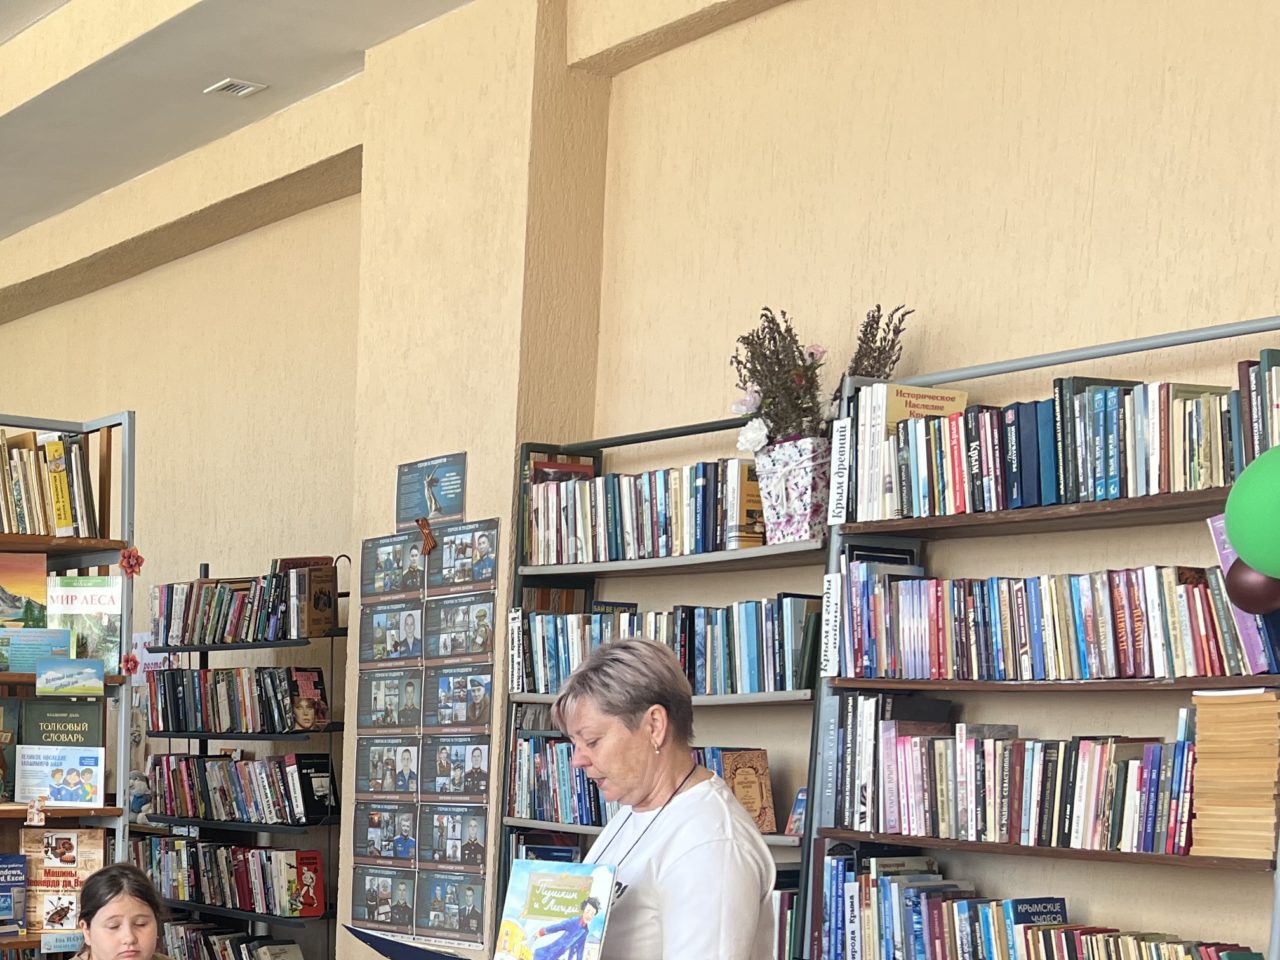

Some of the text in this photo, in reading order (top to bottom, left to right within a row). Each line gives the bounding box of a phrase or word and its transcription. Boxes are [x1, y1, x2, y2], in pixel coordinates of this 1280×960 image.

[896, 389, 956, 402] Историческое
[904, 400, 945, 411] Наследие
[968, 440, 980, 474] Крым
[831, 425, 848, 519] Крым древний
[49, 594, 116, 606] МИР ЛЕСА
[823, 579, 832, 615] годы
[821, 630, 831, 673] Крым
[38, 722, 89, 732] ТОЛКОВЫЙ
[41, 733, 84, 743] СЛОВАРЬ
[1002, 750, 1010, 796] СЕВАСТОПОЛЬ
[7, 874, 25, 882] Excel
[43, 868, 77, 877] Машины
[536, 878, 578, 903] Пушкин
[543, 901, 580, 914] Лицей
[848, 894, 856, 924] Крыма
[1018, 903, 1062, 913] КРЫМСКИЕ
[1031, 914, 1063, 923] ЧУДЕСА
